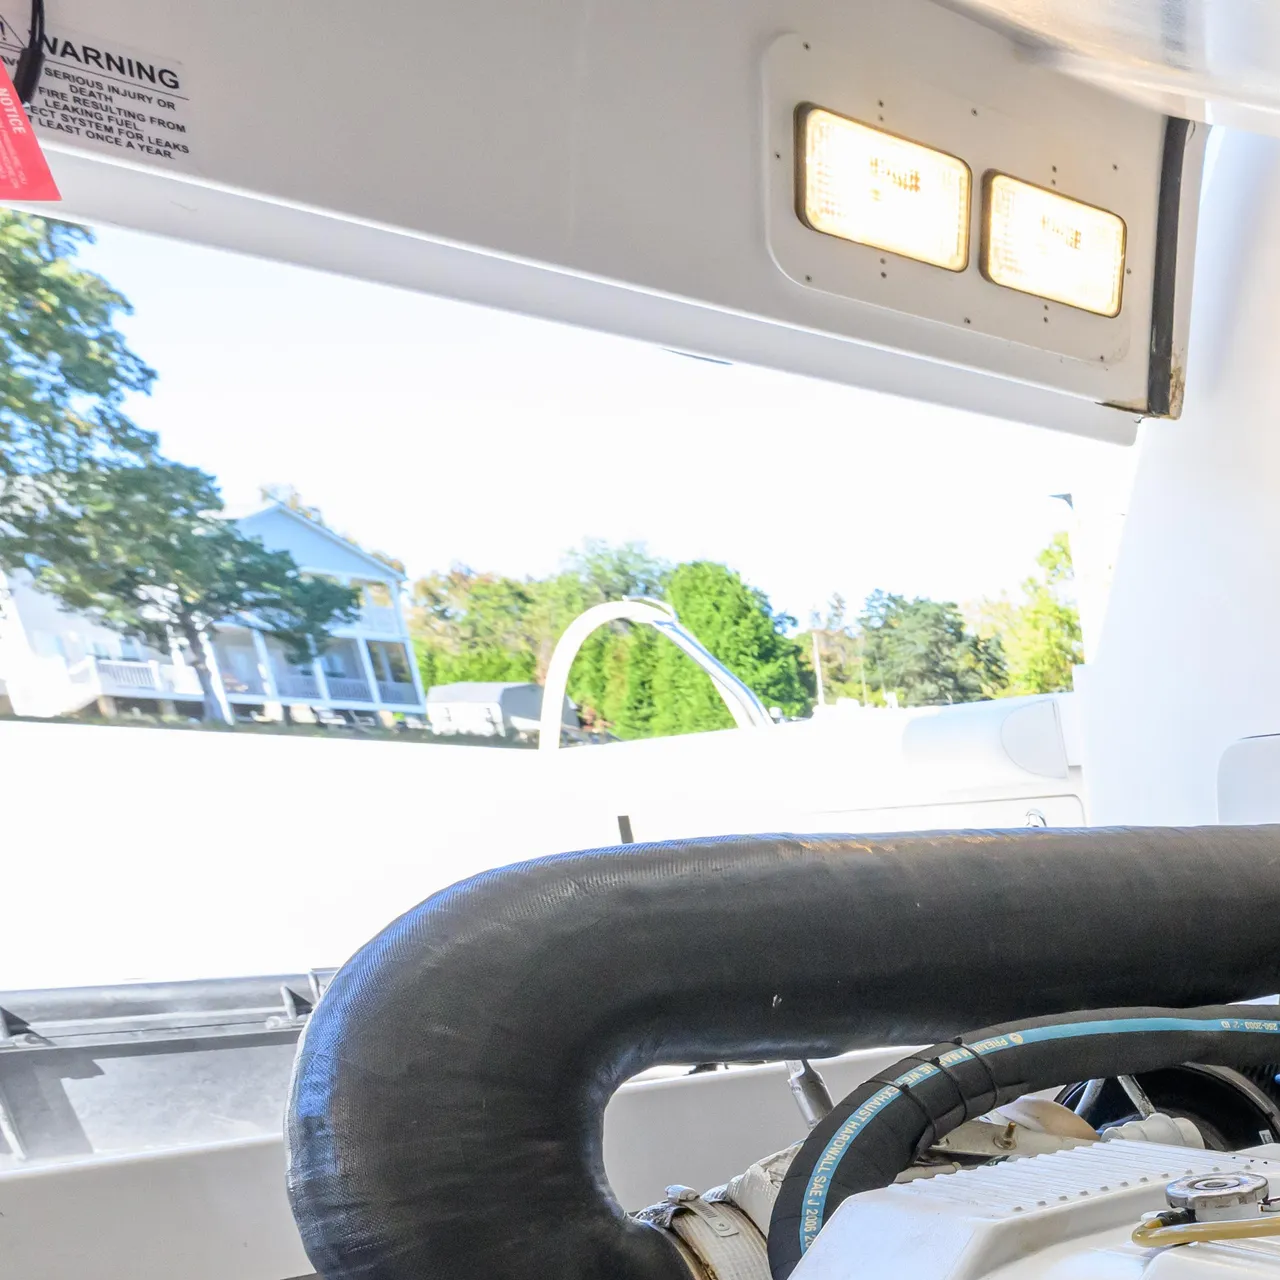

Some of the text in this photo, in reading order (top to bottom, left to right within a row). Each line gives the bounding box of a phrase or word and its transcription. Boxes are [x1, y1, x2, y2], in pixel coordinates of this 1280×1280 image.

[44, 67, 176, 111] SERIOUS INJURY OR
[69, 84, 113, 103] DEATH
[38, 86, 186, 133] FIRE RESULTING FROM
[44, 99, 104, 121] LEAKING
[38, 118, 81, 136] LEAST
[86, 130, 123, 147] ONCE
[126, 141, 135, 150] A
[60, 113, 114, 134] SYSTEM
[118, 128, 144, 142] FOR
[148, 136, 190, 154] LEAKS
[855, 1086, 901, 1123] EXHAUST
[817, 1120, 861, 1173] HARDWALL
[809, 1175, 826, 1197] SAE
[804, 1208, 818, 1233] 2006
